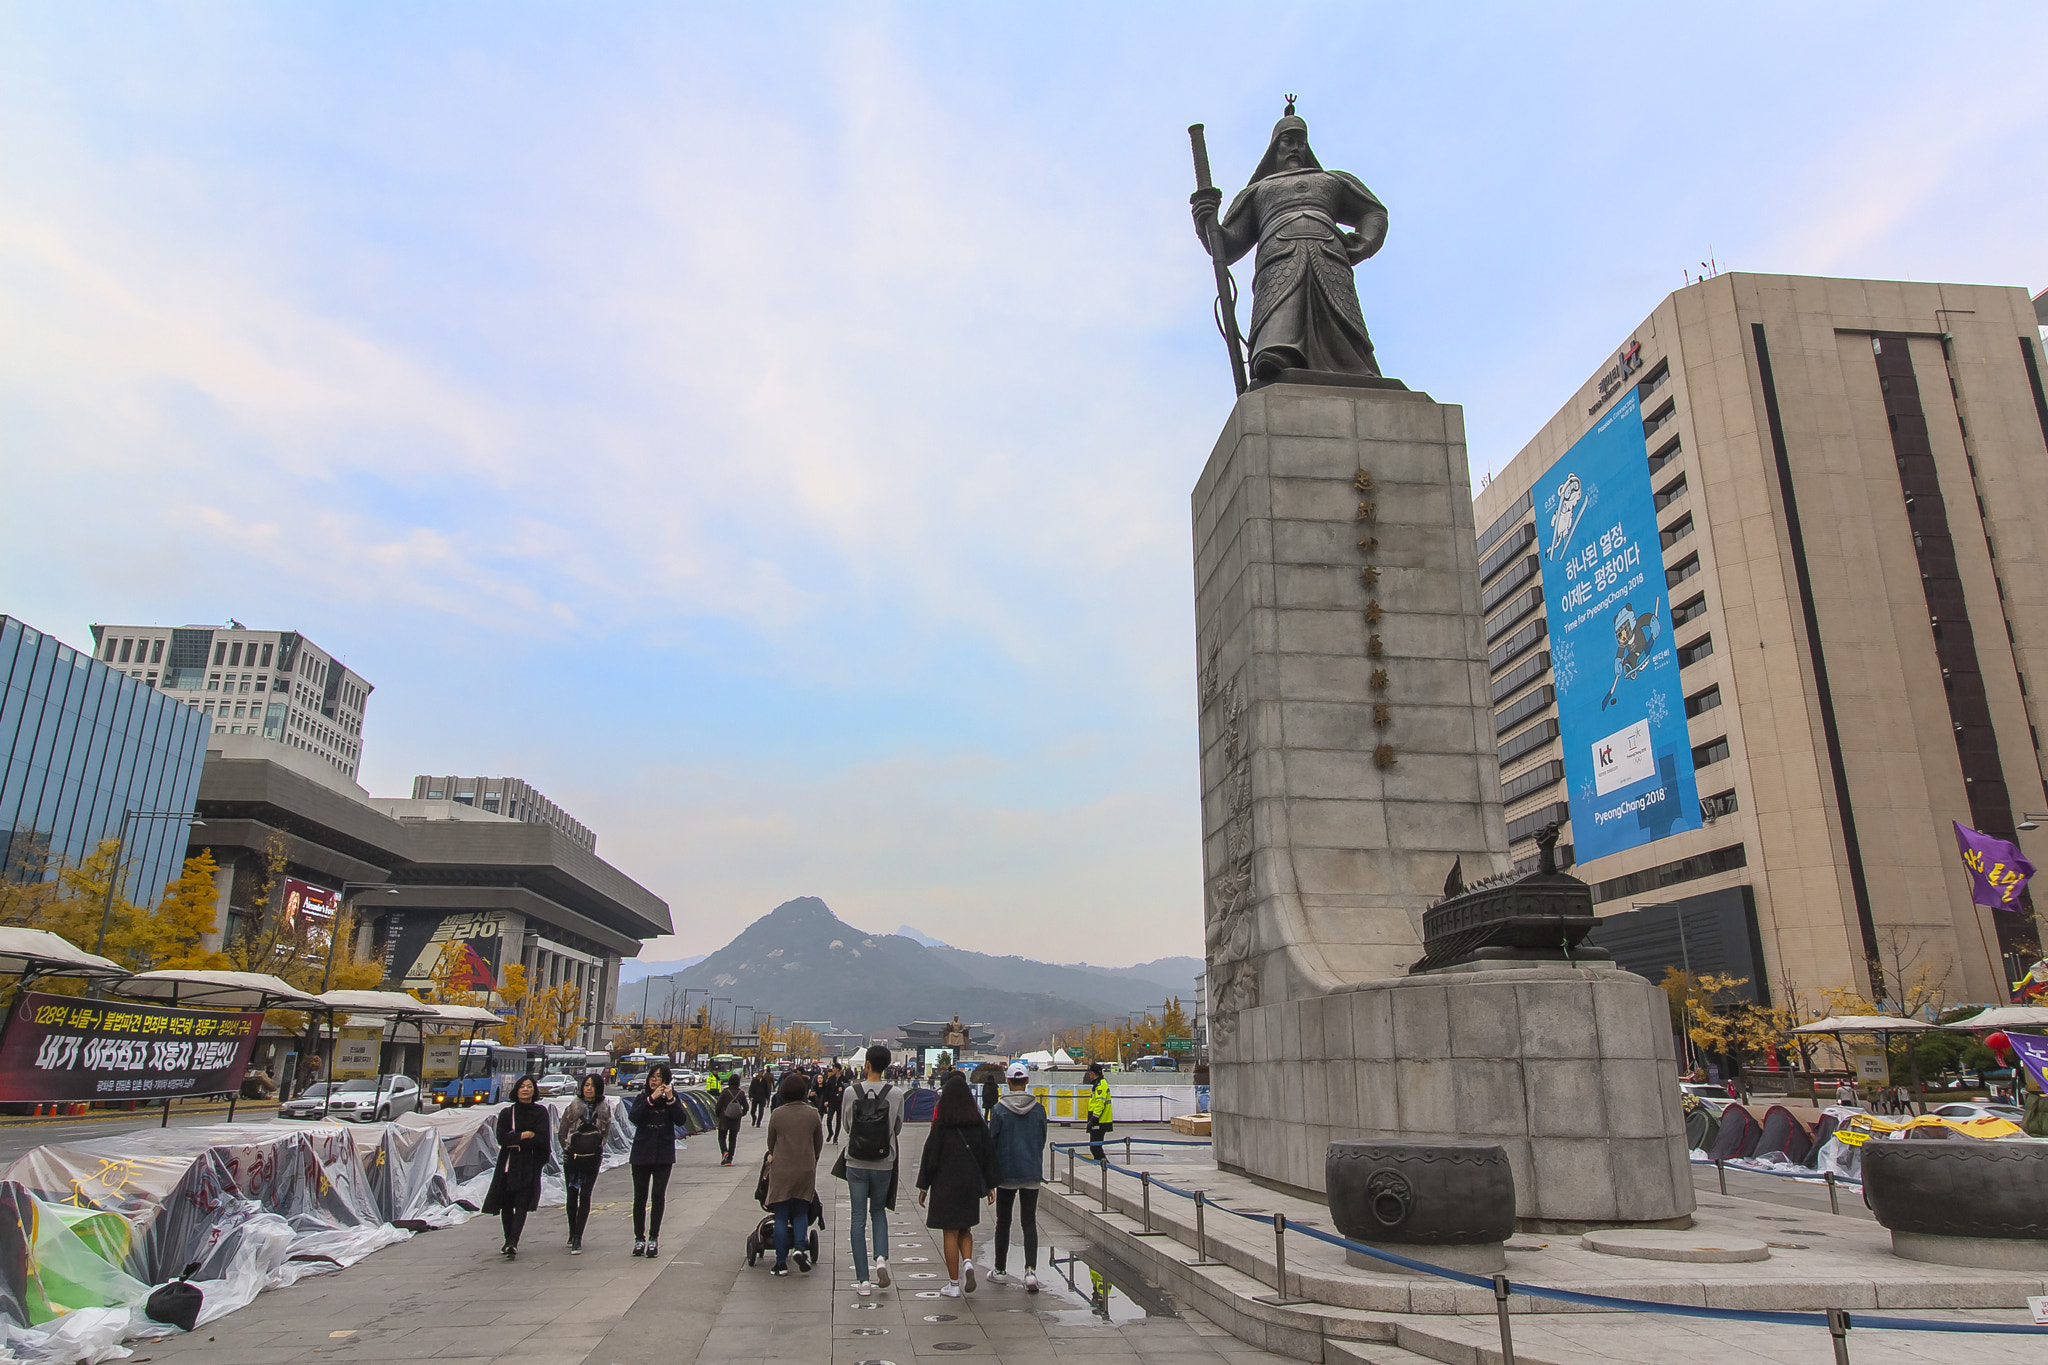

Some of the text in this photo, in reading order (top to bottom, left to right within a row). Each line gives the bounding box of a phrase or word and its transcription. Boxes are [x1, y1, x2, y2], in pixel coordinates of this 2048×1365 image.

[1619, 340, 1641, 381] kt
[1565, 521, 1627, 580] 하나된 열정,
[1561, 541, 1640, 612] 이제는 평창이다
[1564, 572, 1644, 634] Time for PyeongChang 2018
[1599, 744, 1613, 767] kt
[1594, 788, 1666, 825] PyeongChang 2018
[34, 1005, 70, 1028] 128억
[102, 1011, 143, 1033] 불법파견
[141, 1015, 168, 1035] 면죄부
[35, 1034, 83, 1071] 내가
[148, 1041, 193, 1072] 자동차
